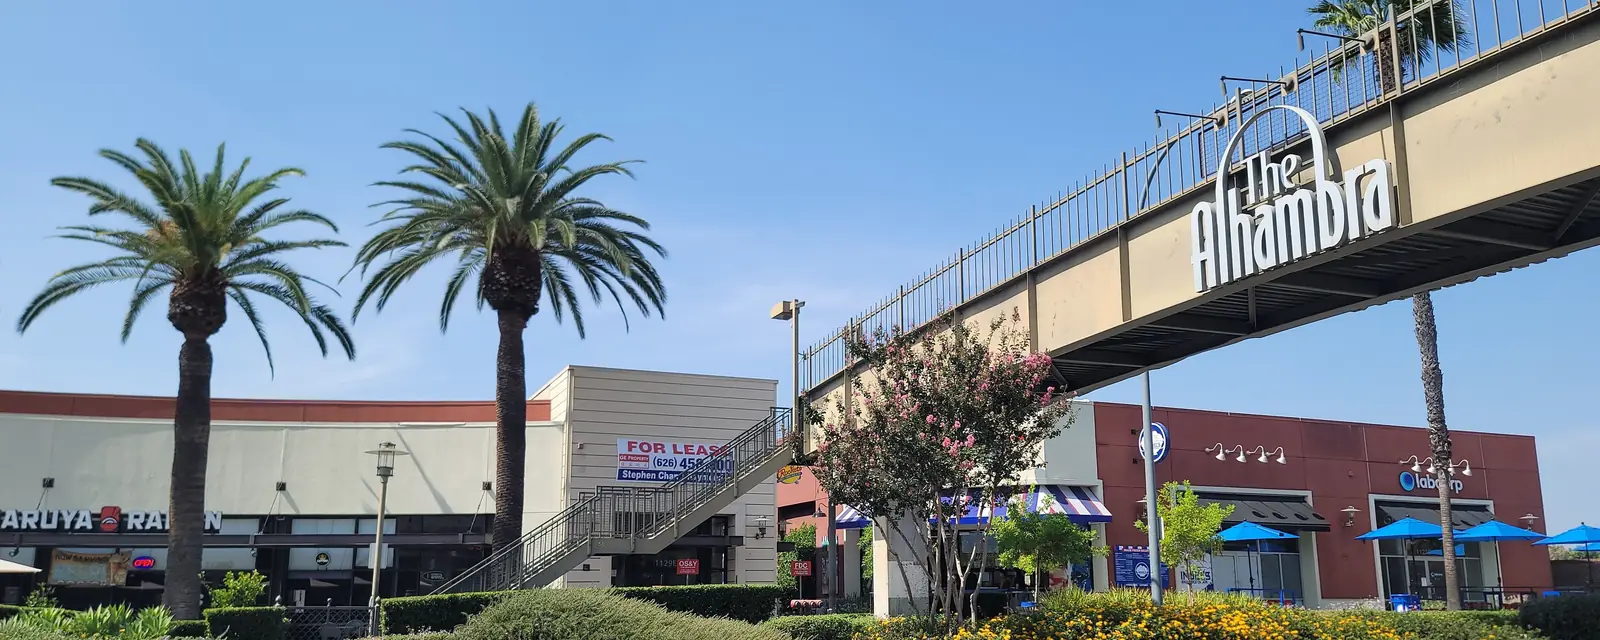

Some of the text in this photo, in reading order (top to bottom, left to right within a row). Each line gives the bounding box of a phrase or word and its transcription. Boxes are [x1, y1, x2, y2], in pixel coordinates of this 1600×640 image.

[1245, 150, 1302, 204] The
[1190, 106, 1396, 293] Alhambra
[627, 441, 666, 454] FOR
[652, 456, 678, 470] (626)
[622, 470, 656, 480] Stephen
[1, 509, 222, 530] ARUYA RAN
[133, 559, 155, 567] OPEN
[678, 560, 698, 568] OS&Y
